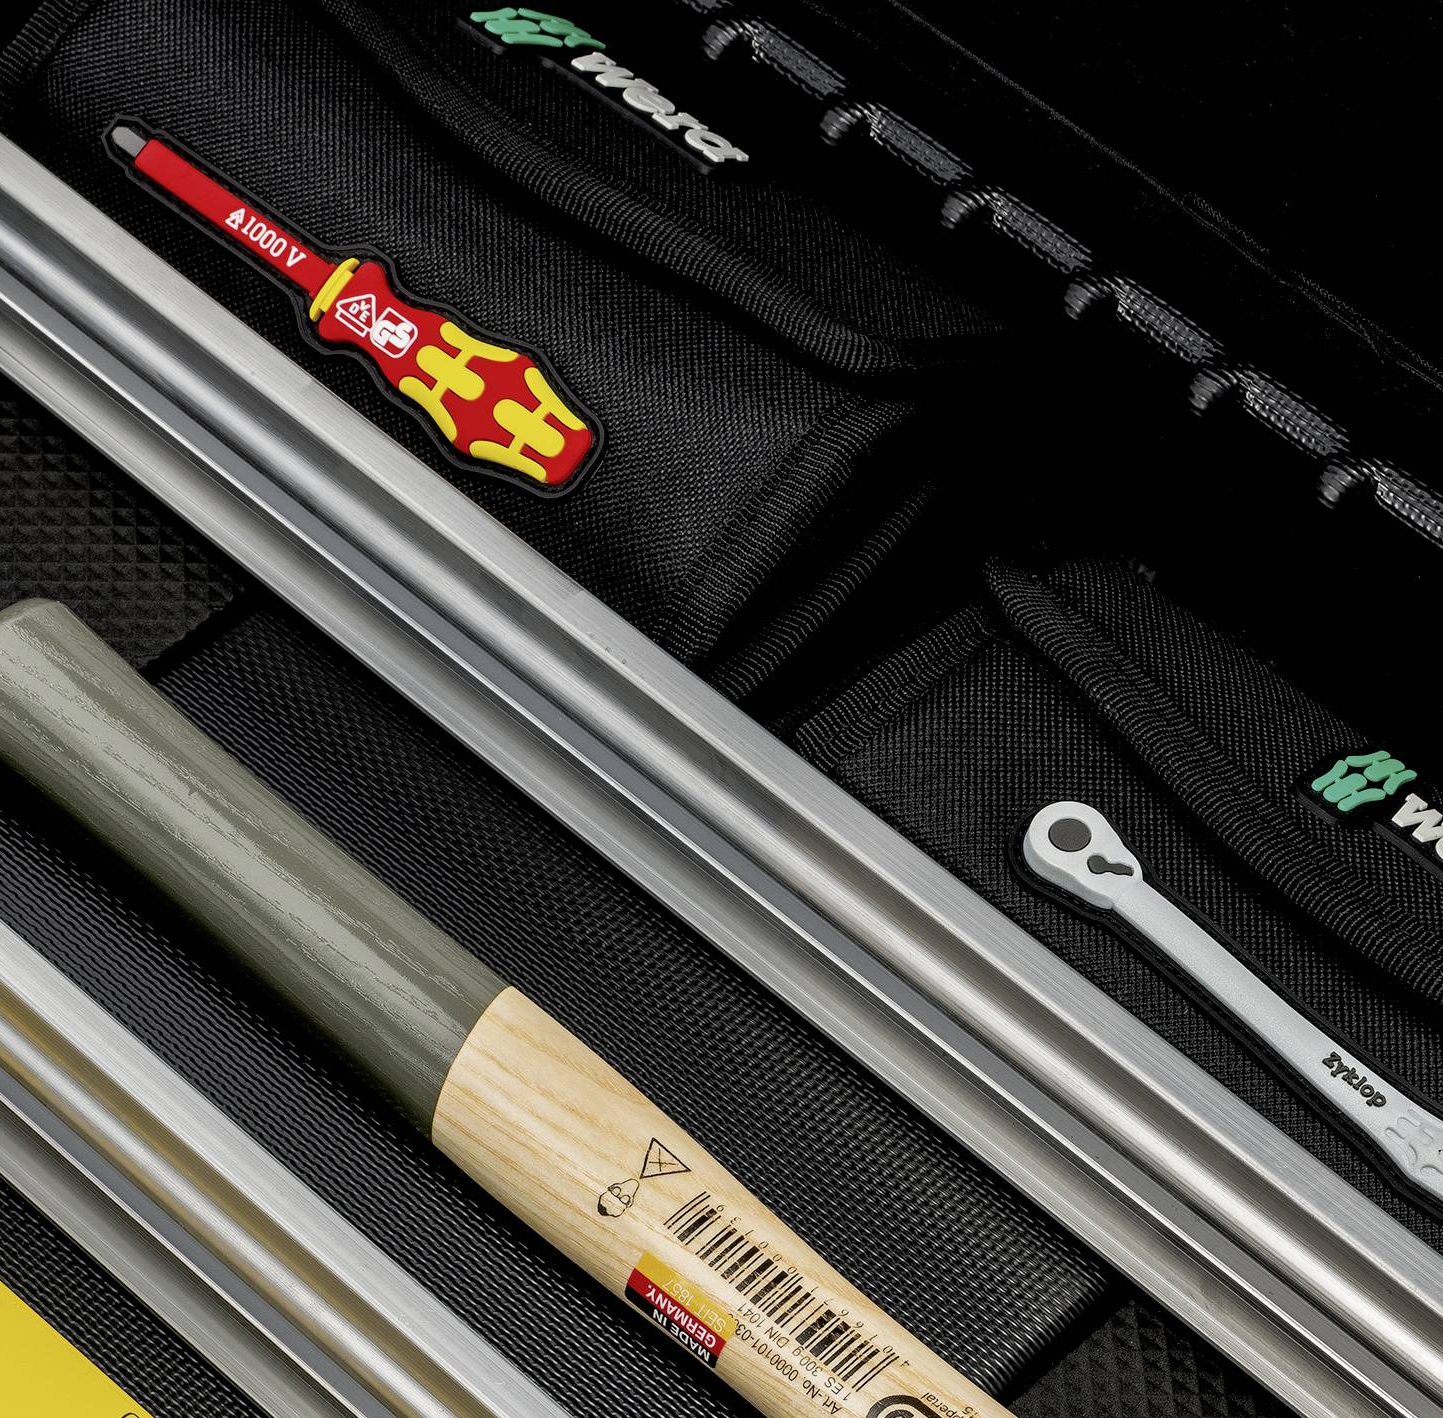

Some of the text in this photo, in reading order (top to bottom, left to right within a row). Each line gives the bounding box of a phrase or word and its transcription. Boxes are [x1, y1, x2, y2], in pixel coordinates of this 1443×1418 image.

[241, 216, 307, 268] 1000 V
[371, 319, 414, 350] GS
[645, 1284, 717, 1349] GERMANY.
[661, 1279, 727, 1333] SEIT 1857
[737, 1302, 766, 1328] 1041
[652, 1308, 711, 1362] MADE IN
[728, 1313, 799, 1382] 0000101-03
[764, 1326, 791, 1349] DIN
[823, 1376, 845, 1396] ES
